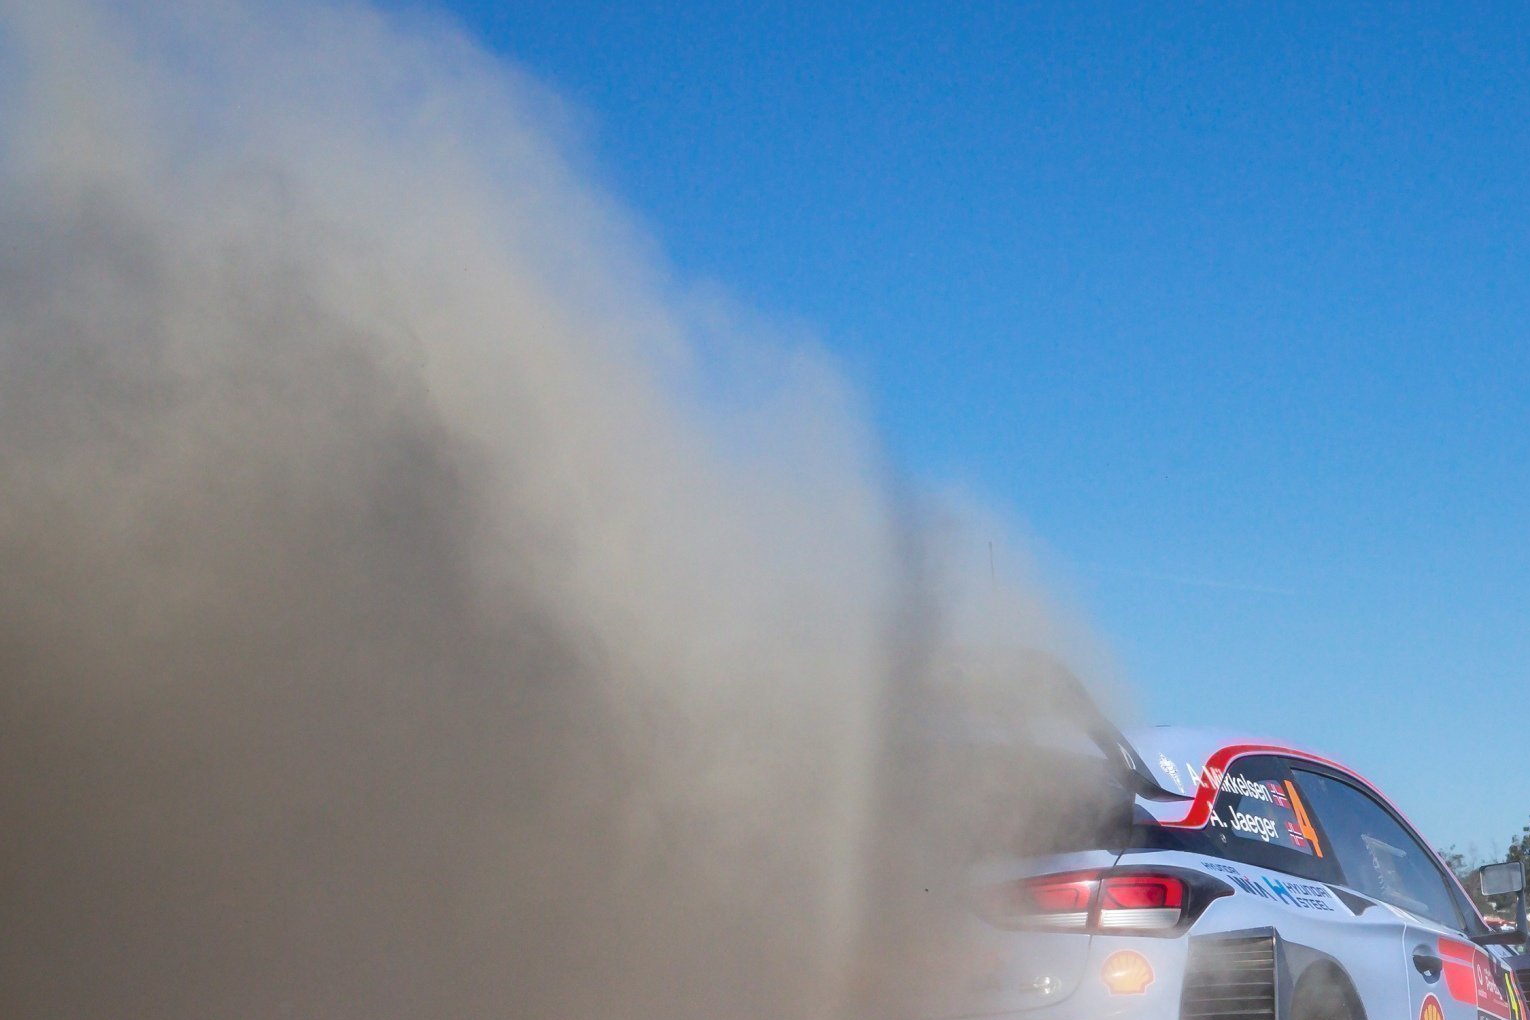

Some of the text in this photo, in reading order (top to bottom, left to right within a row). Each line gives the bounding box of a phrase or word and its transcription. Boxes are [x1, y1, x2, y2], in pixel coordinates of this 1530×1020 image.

[1202, 765, 1274, 803] Mikkelsen
[1229, 805, 1279, 842] Jaeger
[1284, 780, 1323, 858] 4
[1285, 881, 1333, 899] HYUNDAI
[1298, 897, 1335, 912] STEEL
